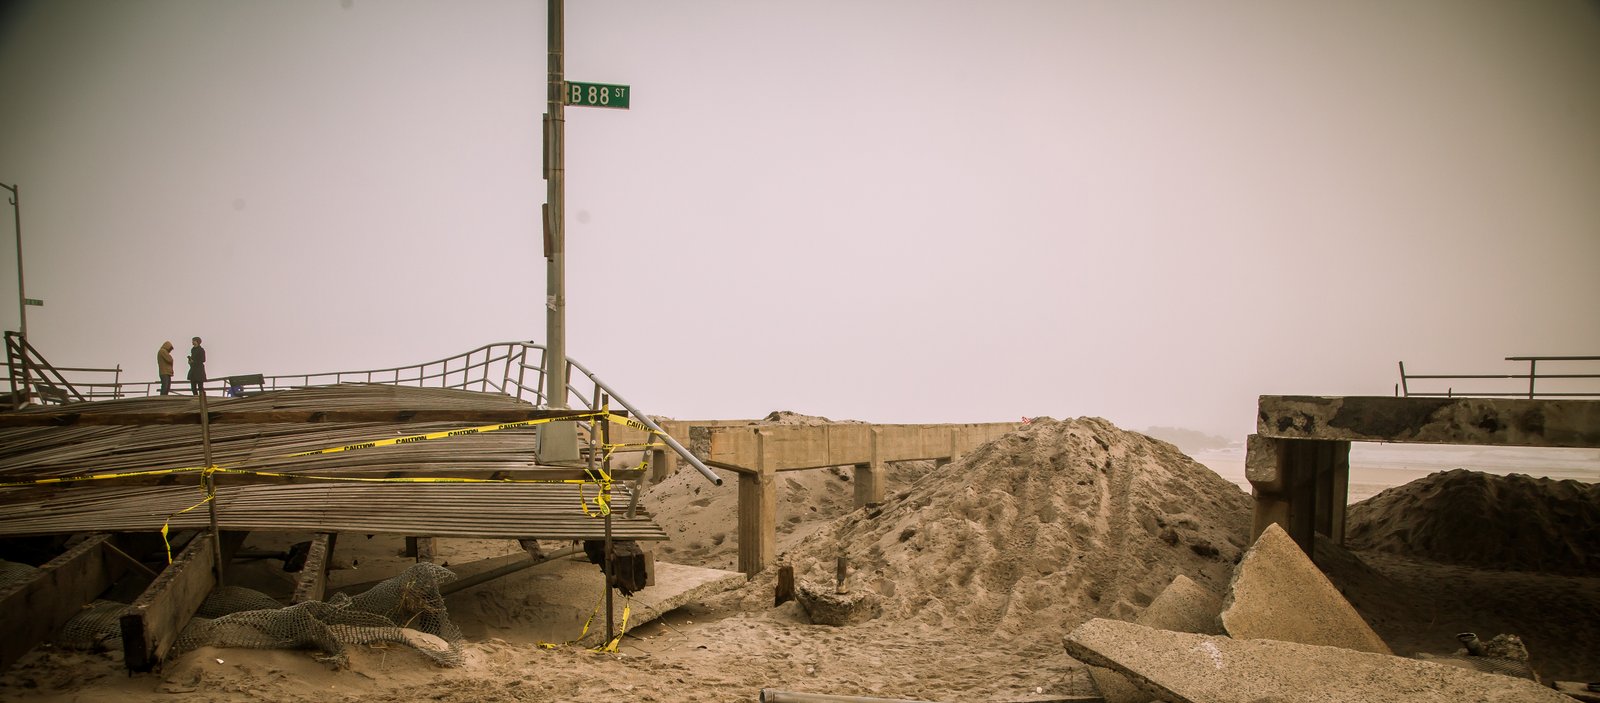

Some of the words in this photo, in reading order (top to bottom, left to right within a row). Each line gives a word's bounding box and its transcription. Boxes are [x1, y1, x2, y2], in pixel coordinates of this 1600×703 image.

[572, 85, 581, 103] B
[588, 86, 609, 105] 88
[615, 88, 625, 97] ST
[344, 442, 376, 451] CAUTION
[396, 435, 427, 444] CAUTION
[448, 428, 479, 437] CAUTION
